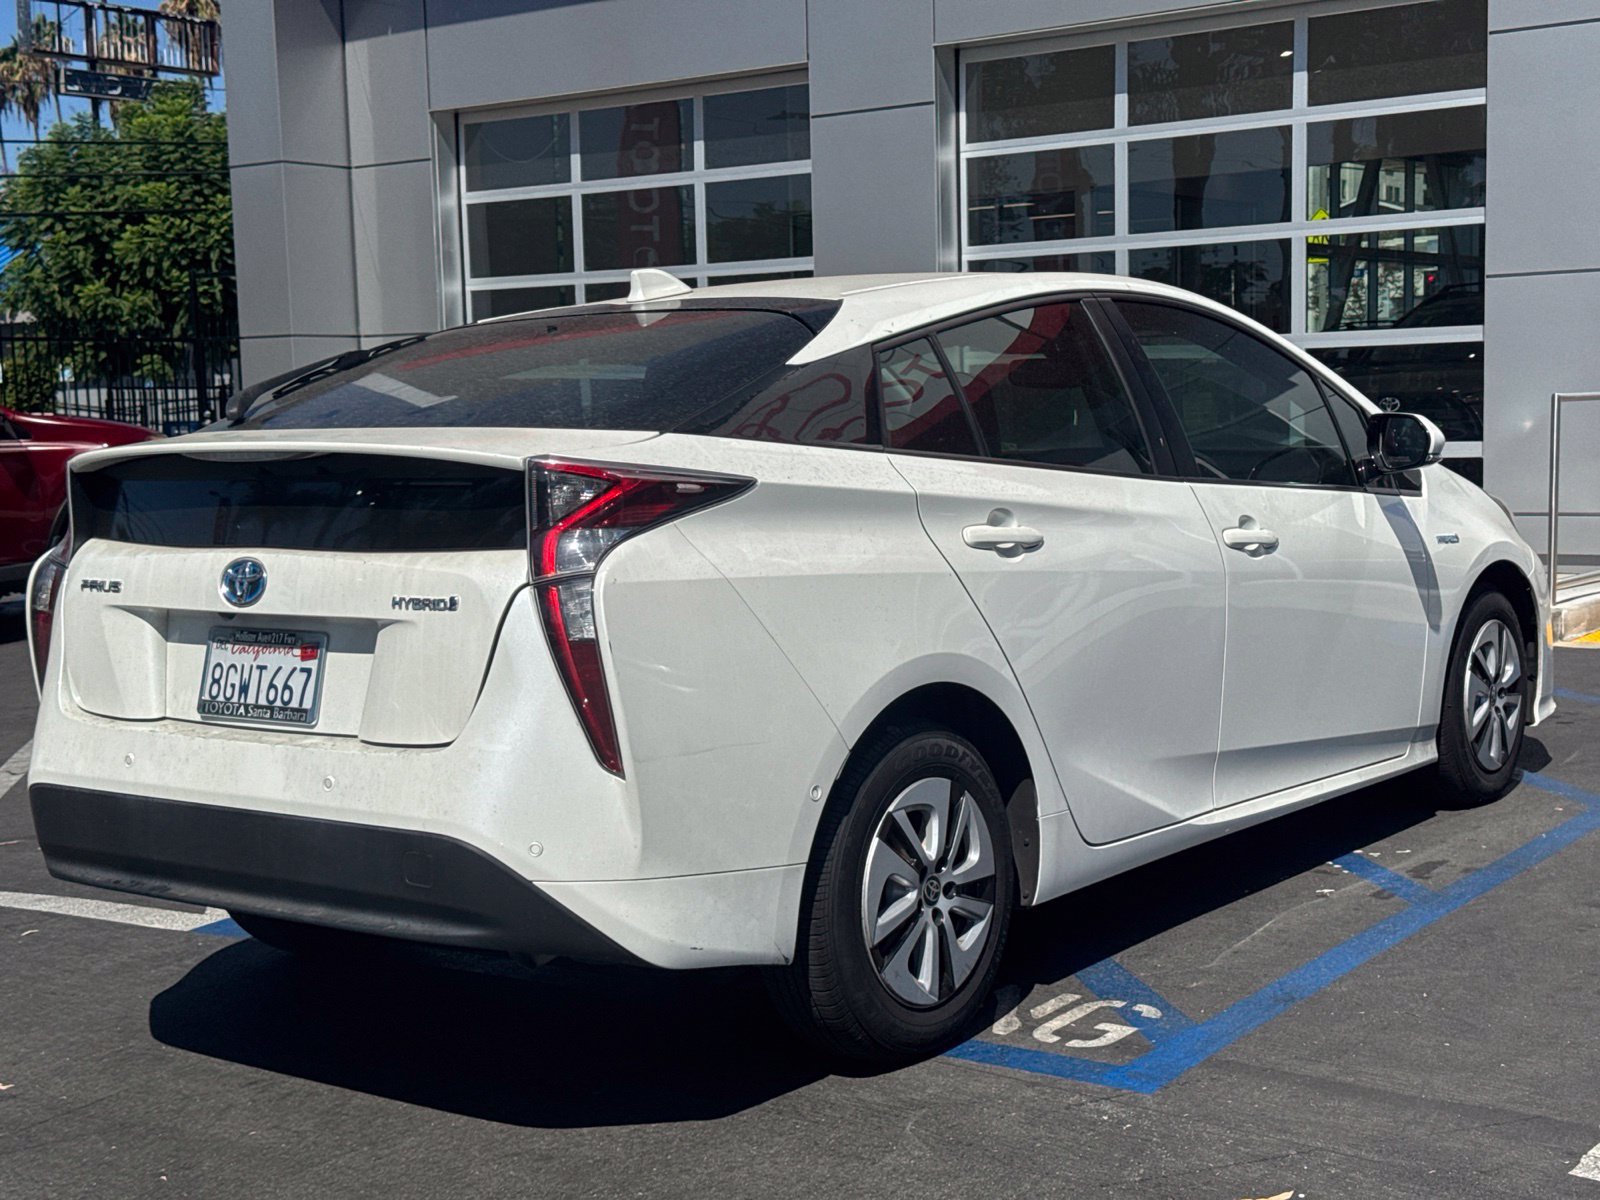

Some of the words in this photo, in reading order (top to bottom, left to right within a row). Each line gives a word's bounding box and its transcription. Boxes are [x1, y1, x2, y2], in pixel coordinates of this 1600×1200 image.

[81, 579, 122, 594] PRIUS
[391, 595, 448, 612] HYBRID
[229, 640, 300, 662] California
[208, 661, 313, 709] 8GWT667
[204, 701, 246, 716] TOYOTA
[247, 705, 271, 719] Santa
[272, 708, 306, 722] Barbara
